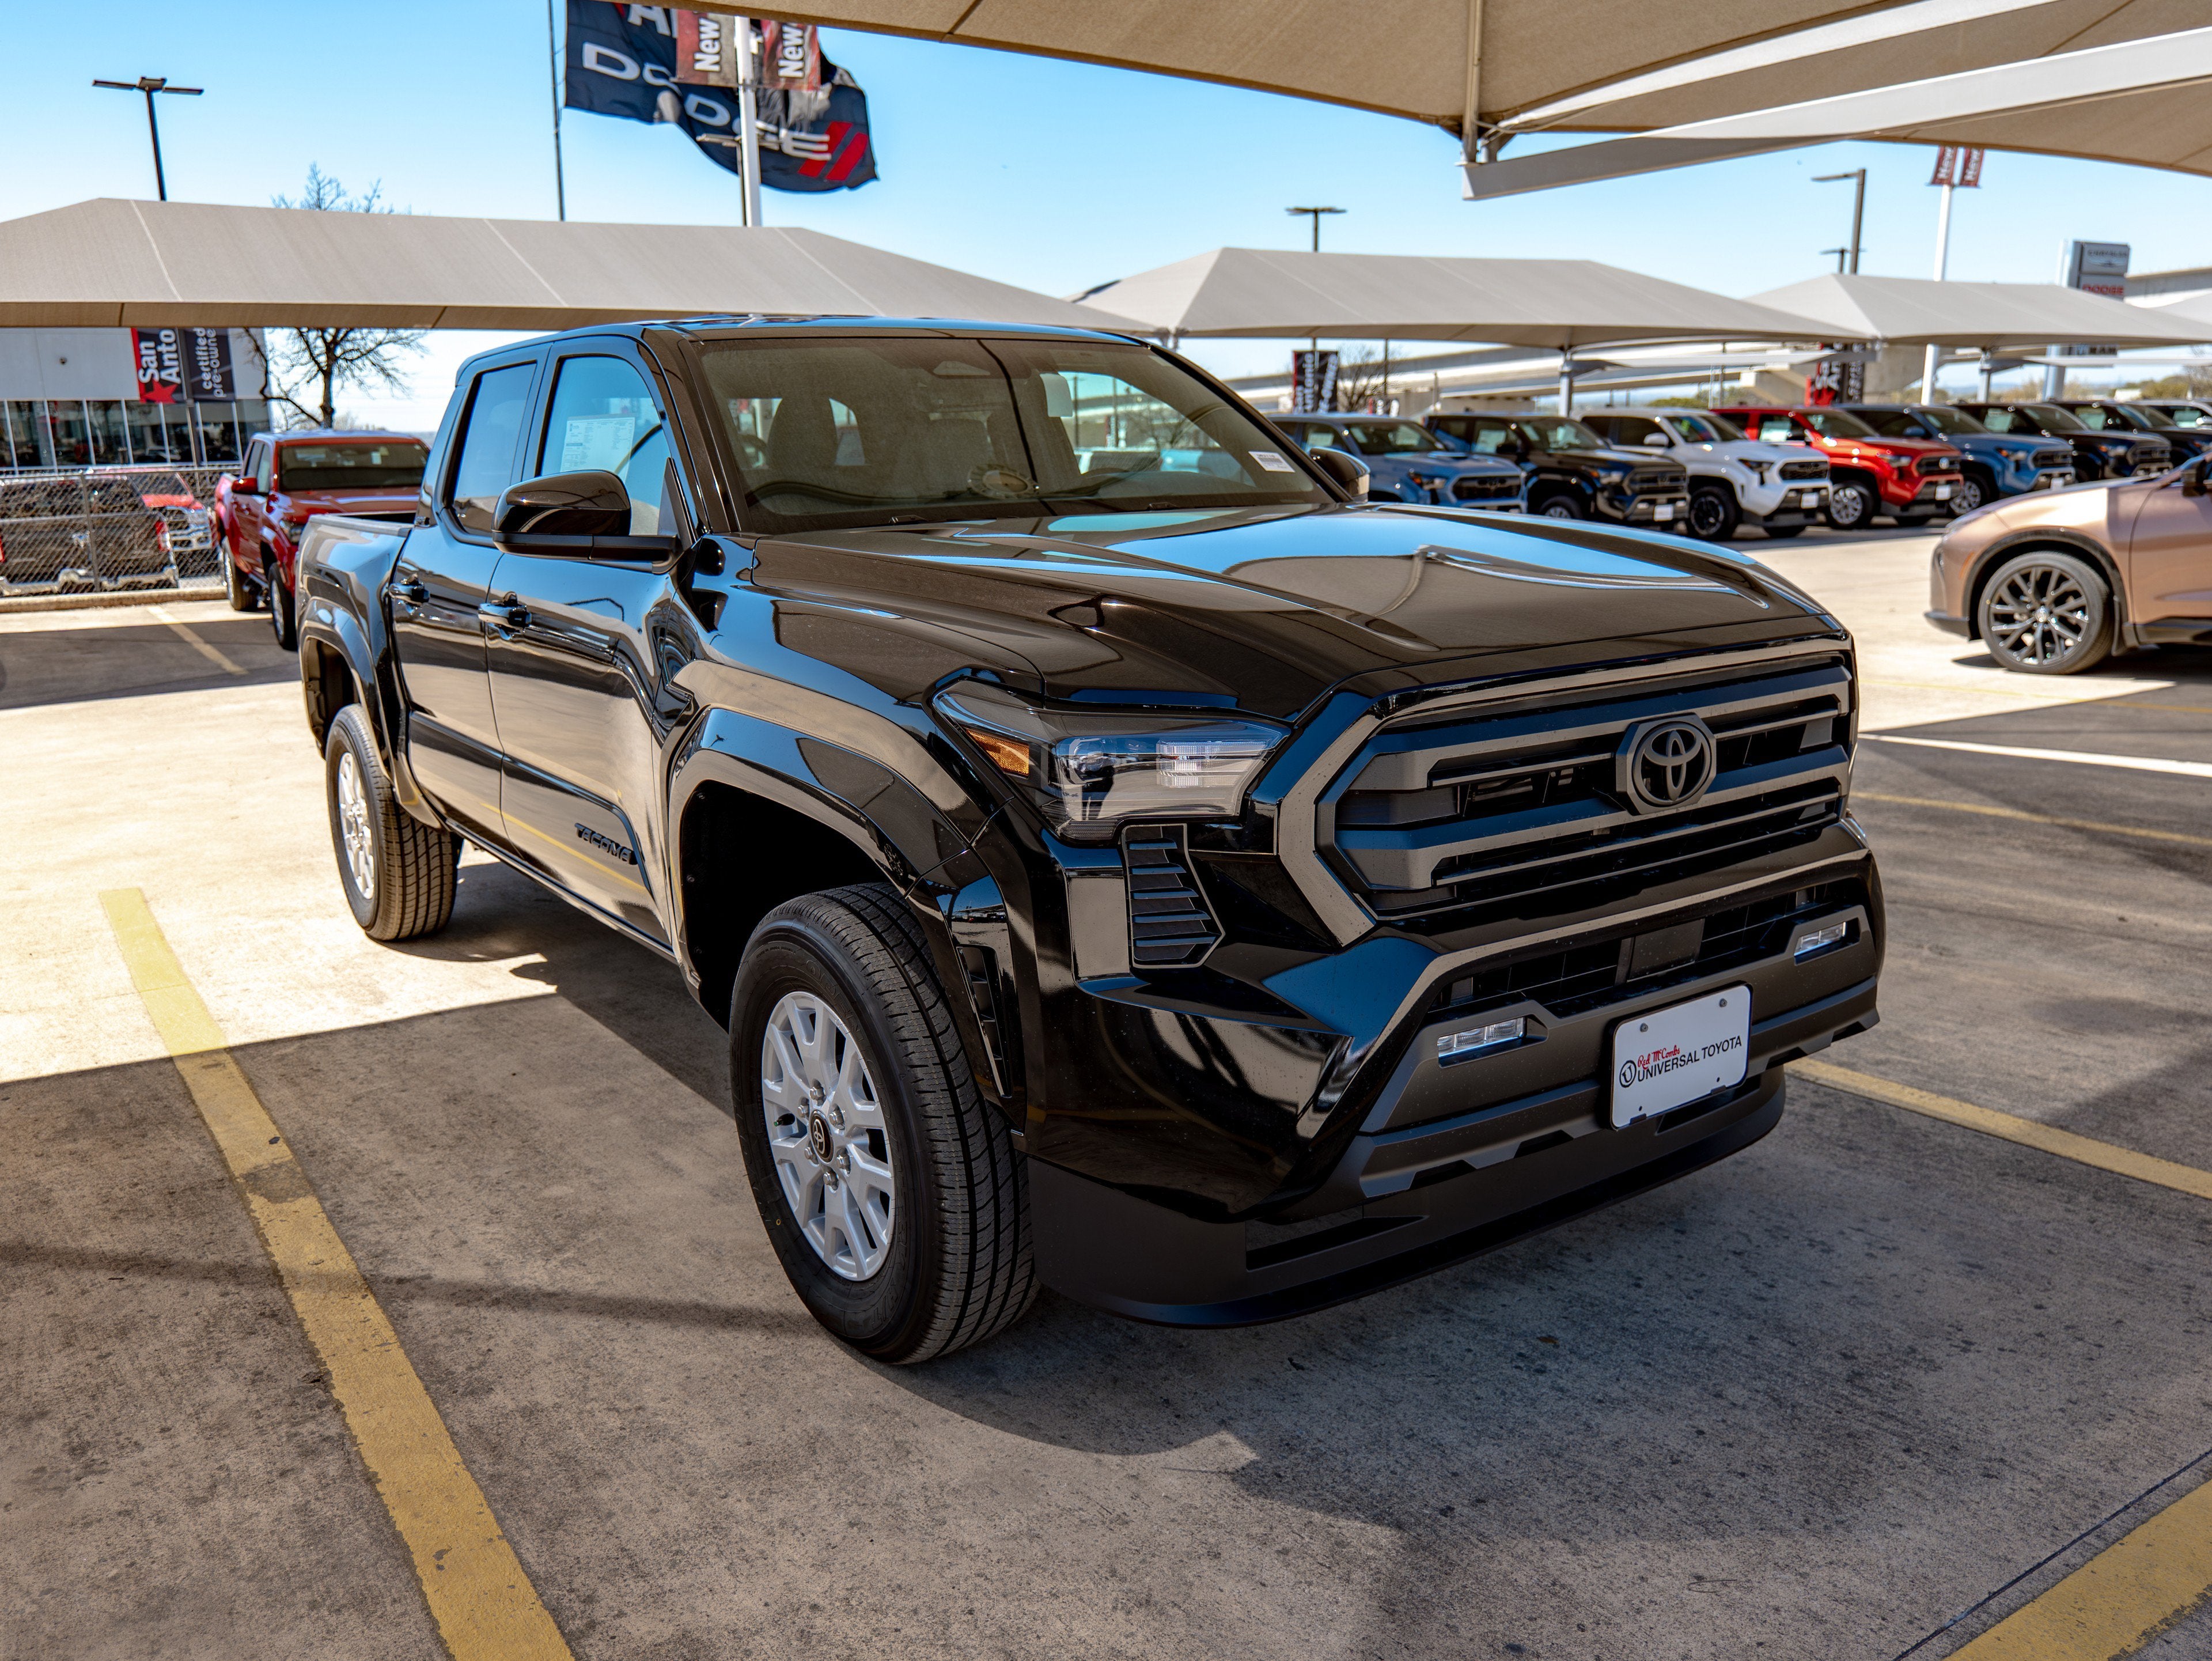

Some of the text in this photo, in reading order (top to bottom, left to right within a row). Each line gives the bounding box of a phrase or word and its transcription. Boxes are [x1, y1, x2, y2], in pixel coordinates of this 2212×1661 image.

[694, 17, 721, 71] New
[778, 23, 805, 78] New
[138, 341, 160, 383] San
[1637, 1045, 1680, 1070] Red McCombs
[1637, 1050, 1700, 1082] UNIVERSAL
[1702, 1035, 1742, 1060] TOYOTA
